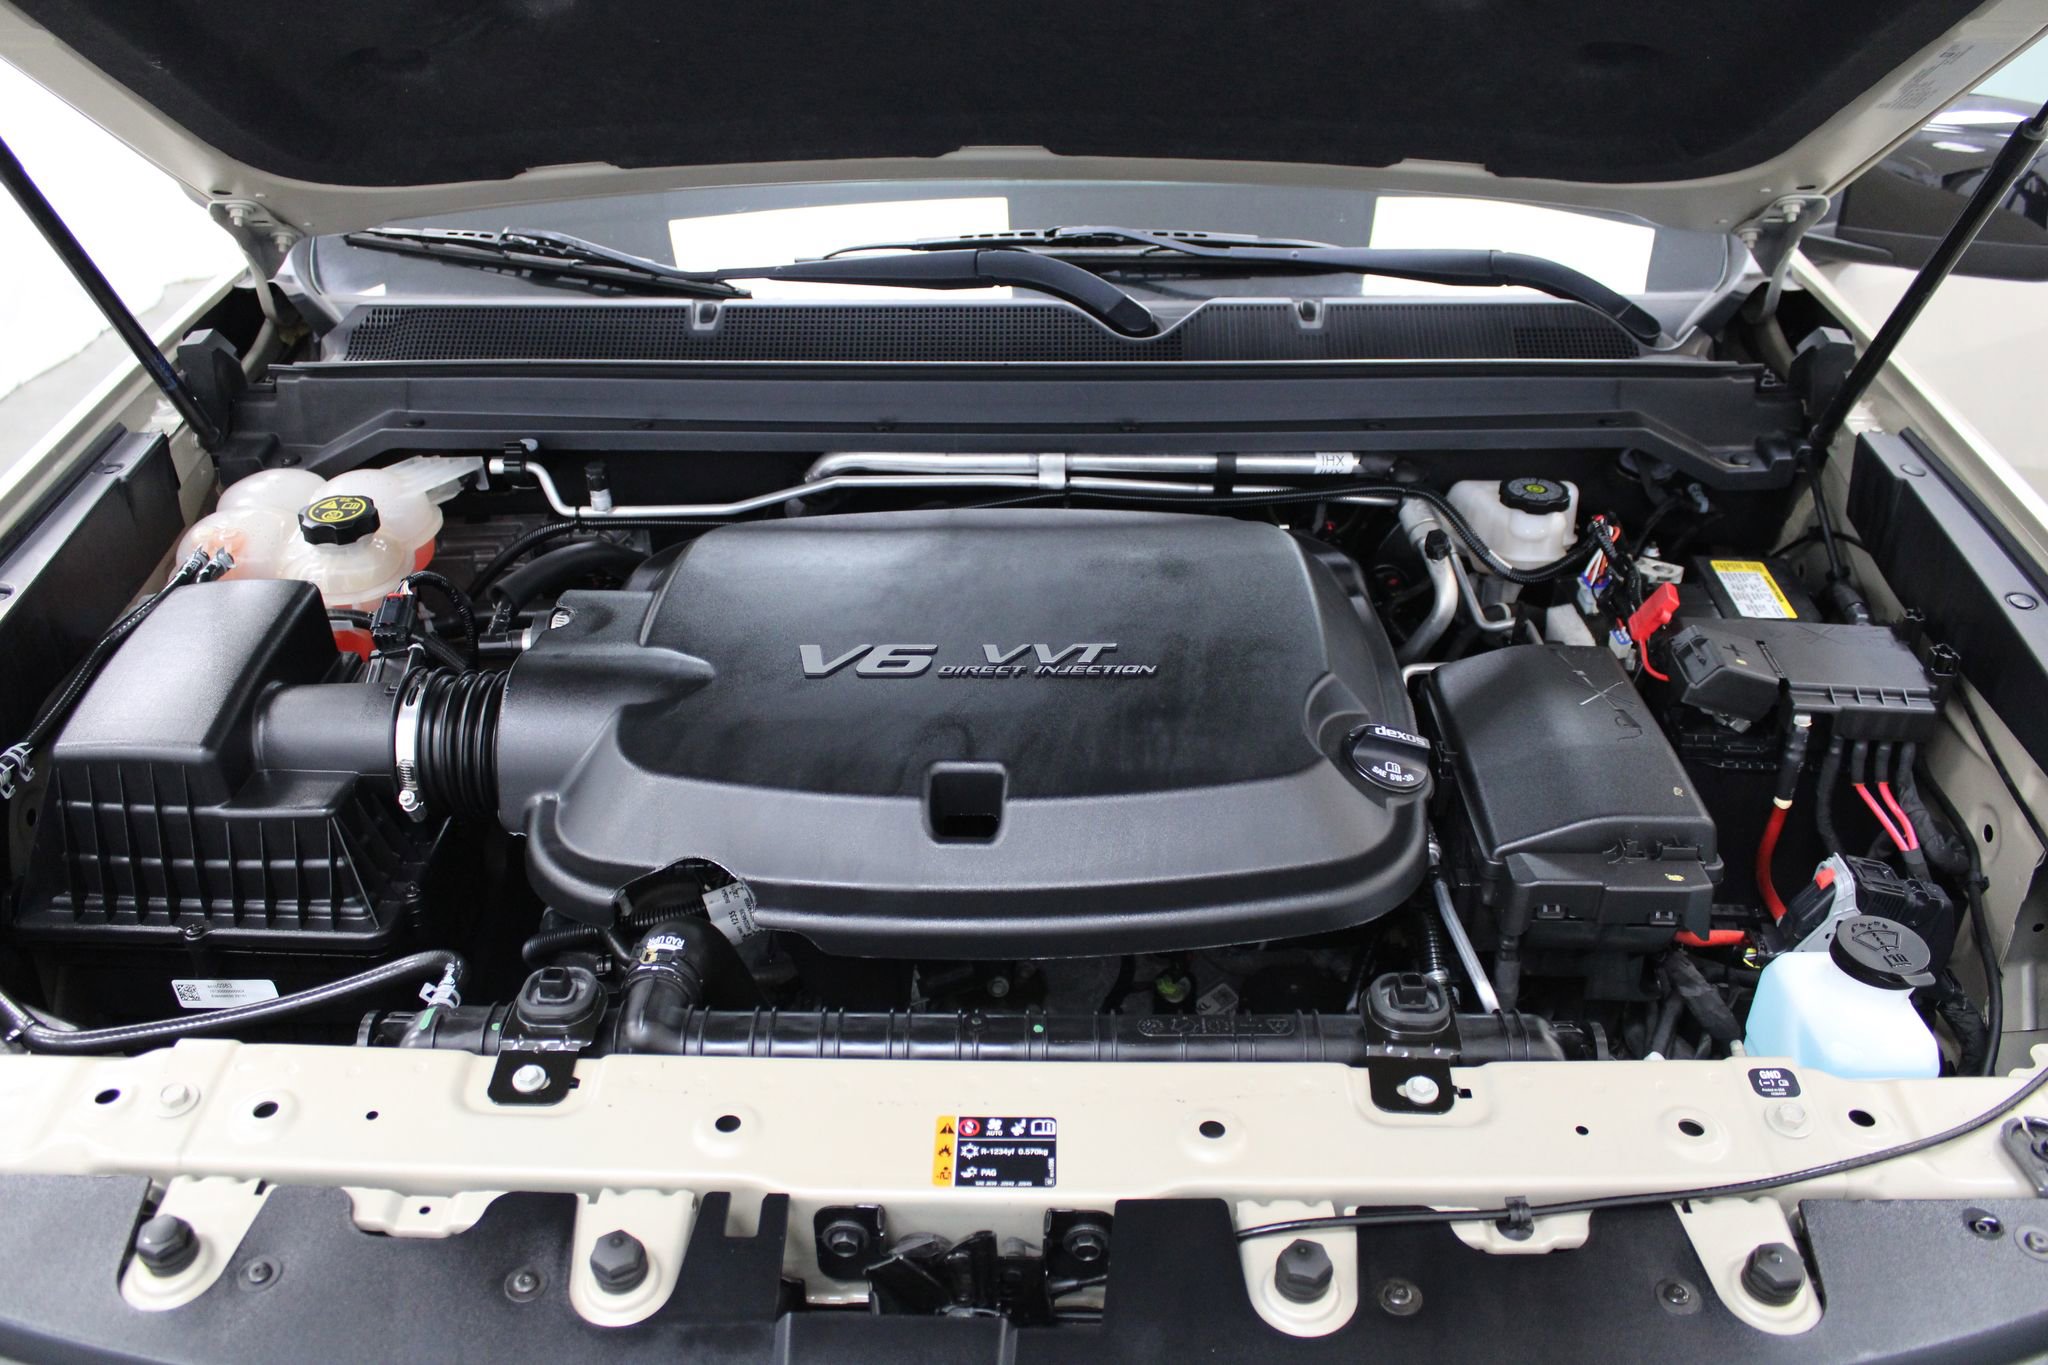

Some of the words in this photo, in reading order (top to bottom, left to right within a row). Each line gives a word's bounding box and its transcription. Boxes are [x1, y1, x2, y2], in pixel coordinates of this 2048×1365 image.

[799, 643, 938, 677] V6
[982, 642, 1118, 664] VVT
[937, 664, 1028, 677] DIRECT
[1034, 664, 1157, 677] INJECTION
[1375, 726, 1425, 746] dexos
[1372, 766, 1387, 777] SAE
[1759, 1070, 1781, 1079] GND
[980, 1147, 1015, 1157] R-1234yf
[1018, 1147, 1049, 1157] 0.570kg
[980, 1168, 997, 1177] PAG
